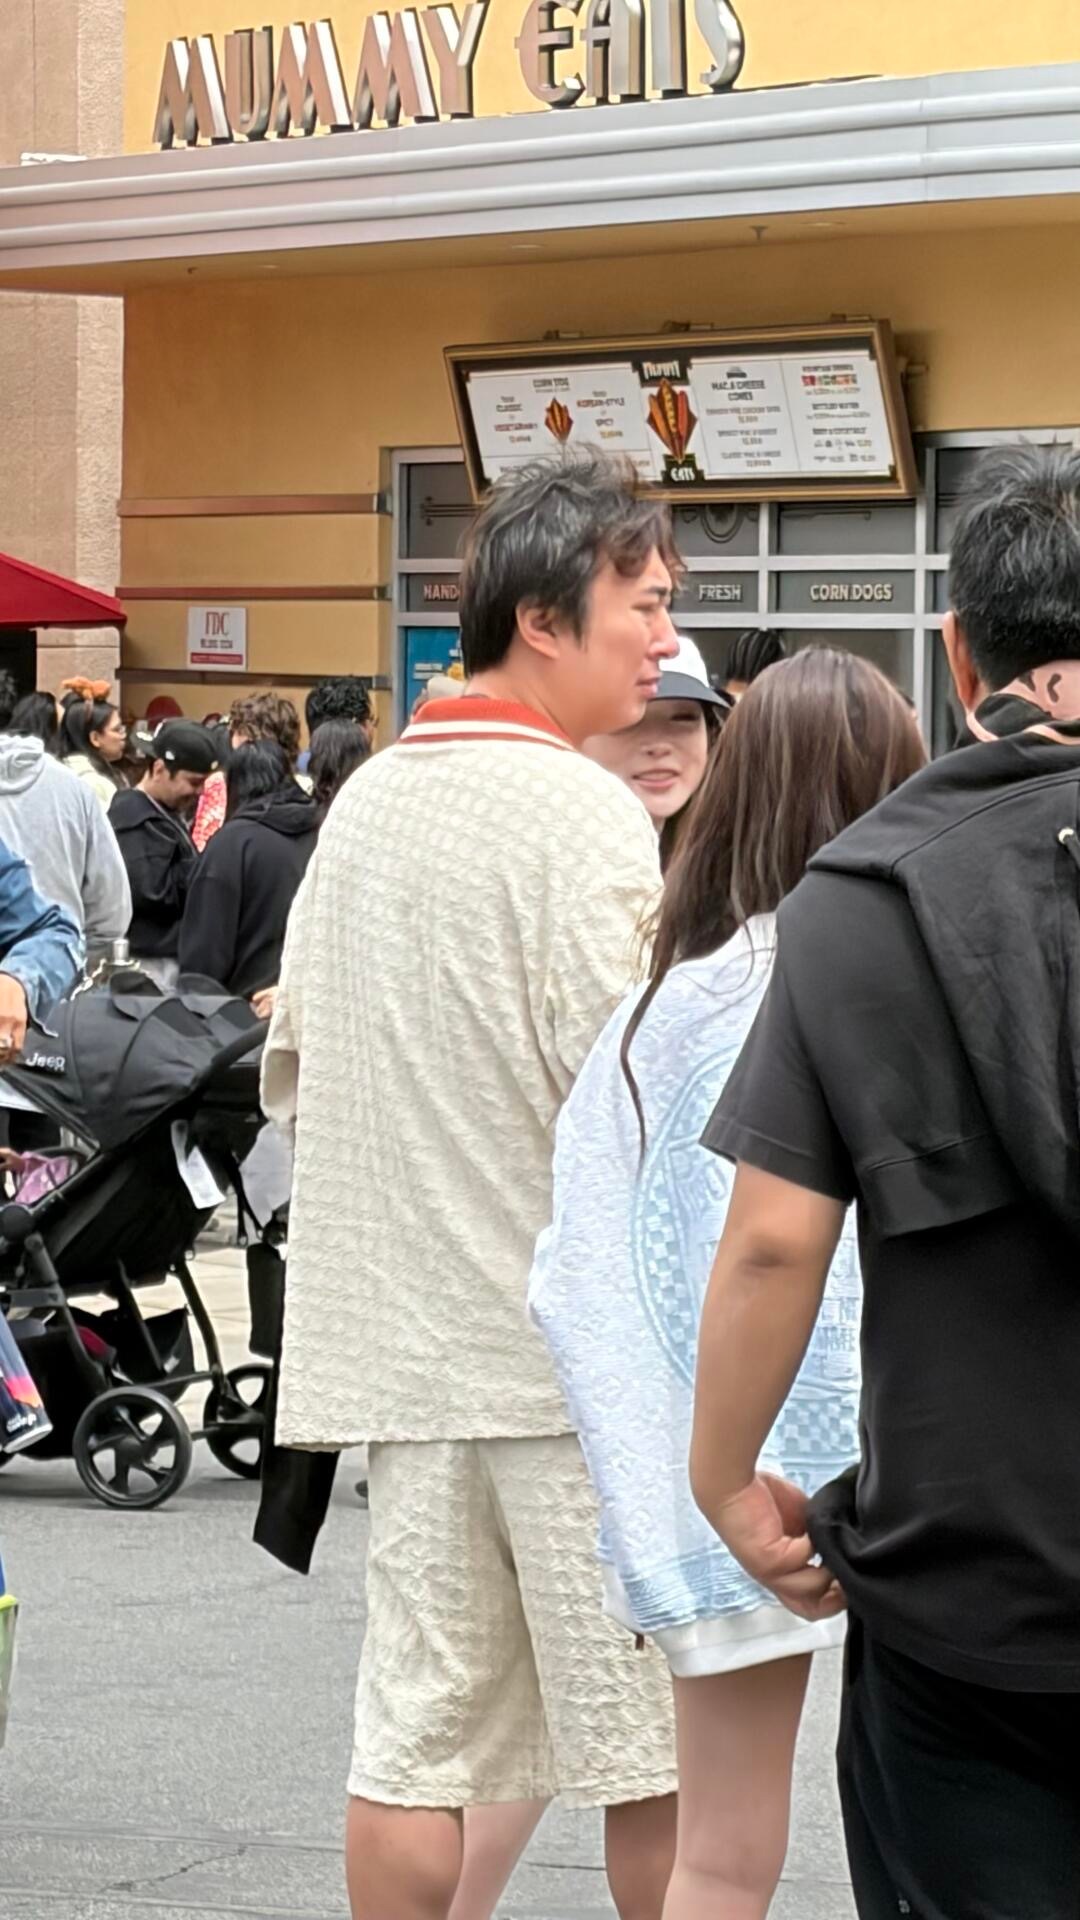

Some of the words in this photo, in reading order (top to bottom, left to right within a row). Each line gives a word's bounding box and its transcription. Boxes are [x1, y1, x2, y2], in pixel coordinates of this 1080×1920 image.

[153, 0, 489, 149] MUMMY
[698, 584, 742, 602] FRESH
[810, 583, 849, 601] CORN
[851, 583, 893, 601] DOGS
[25, 1052, 66, 1072] Jeep
